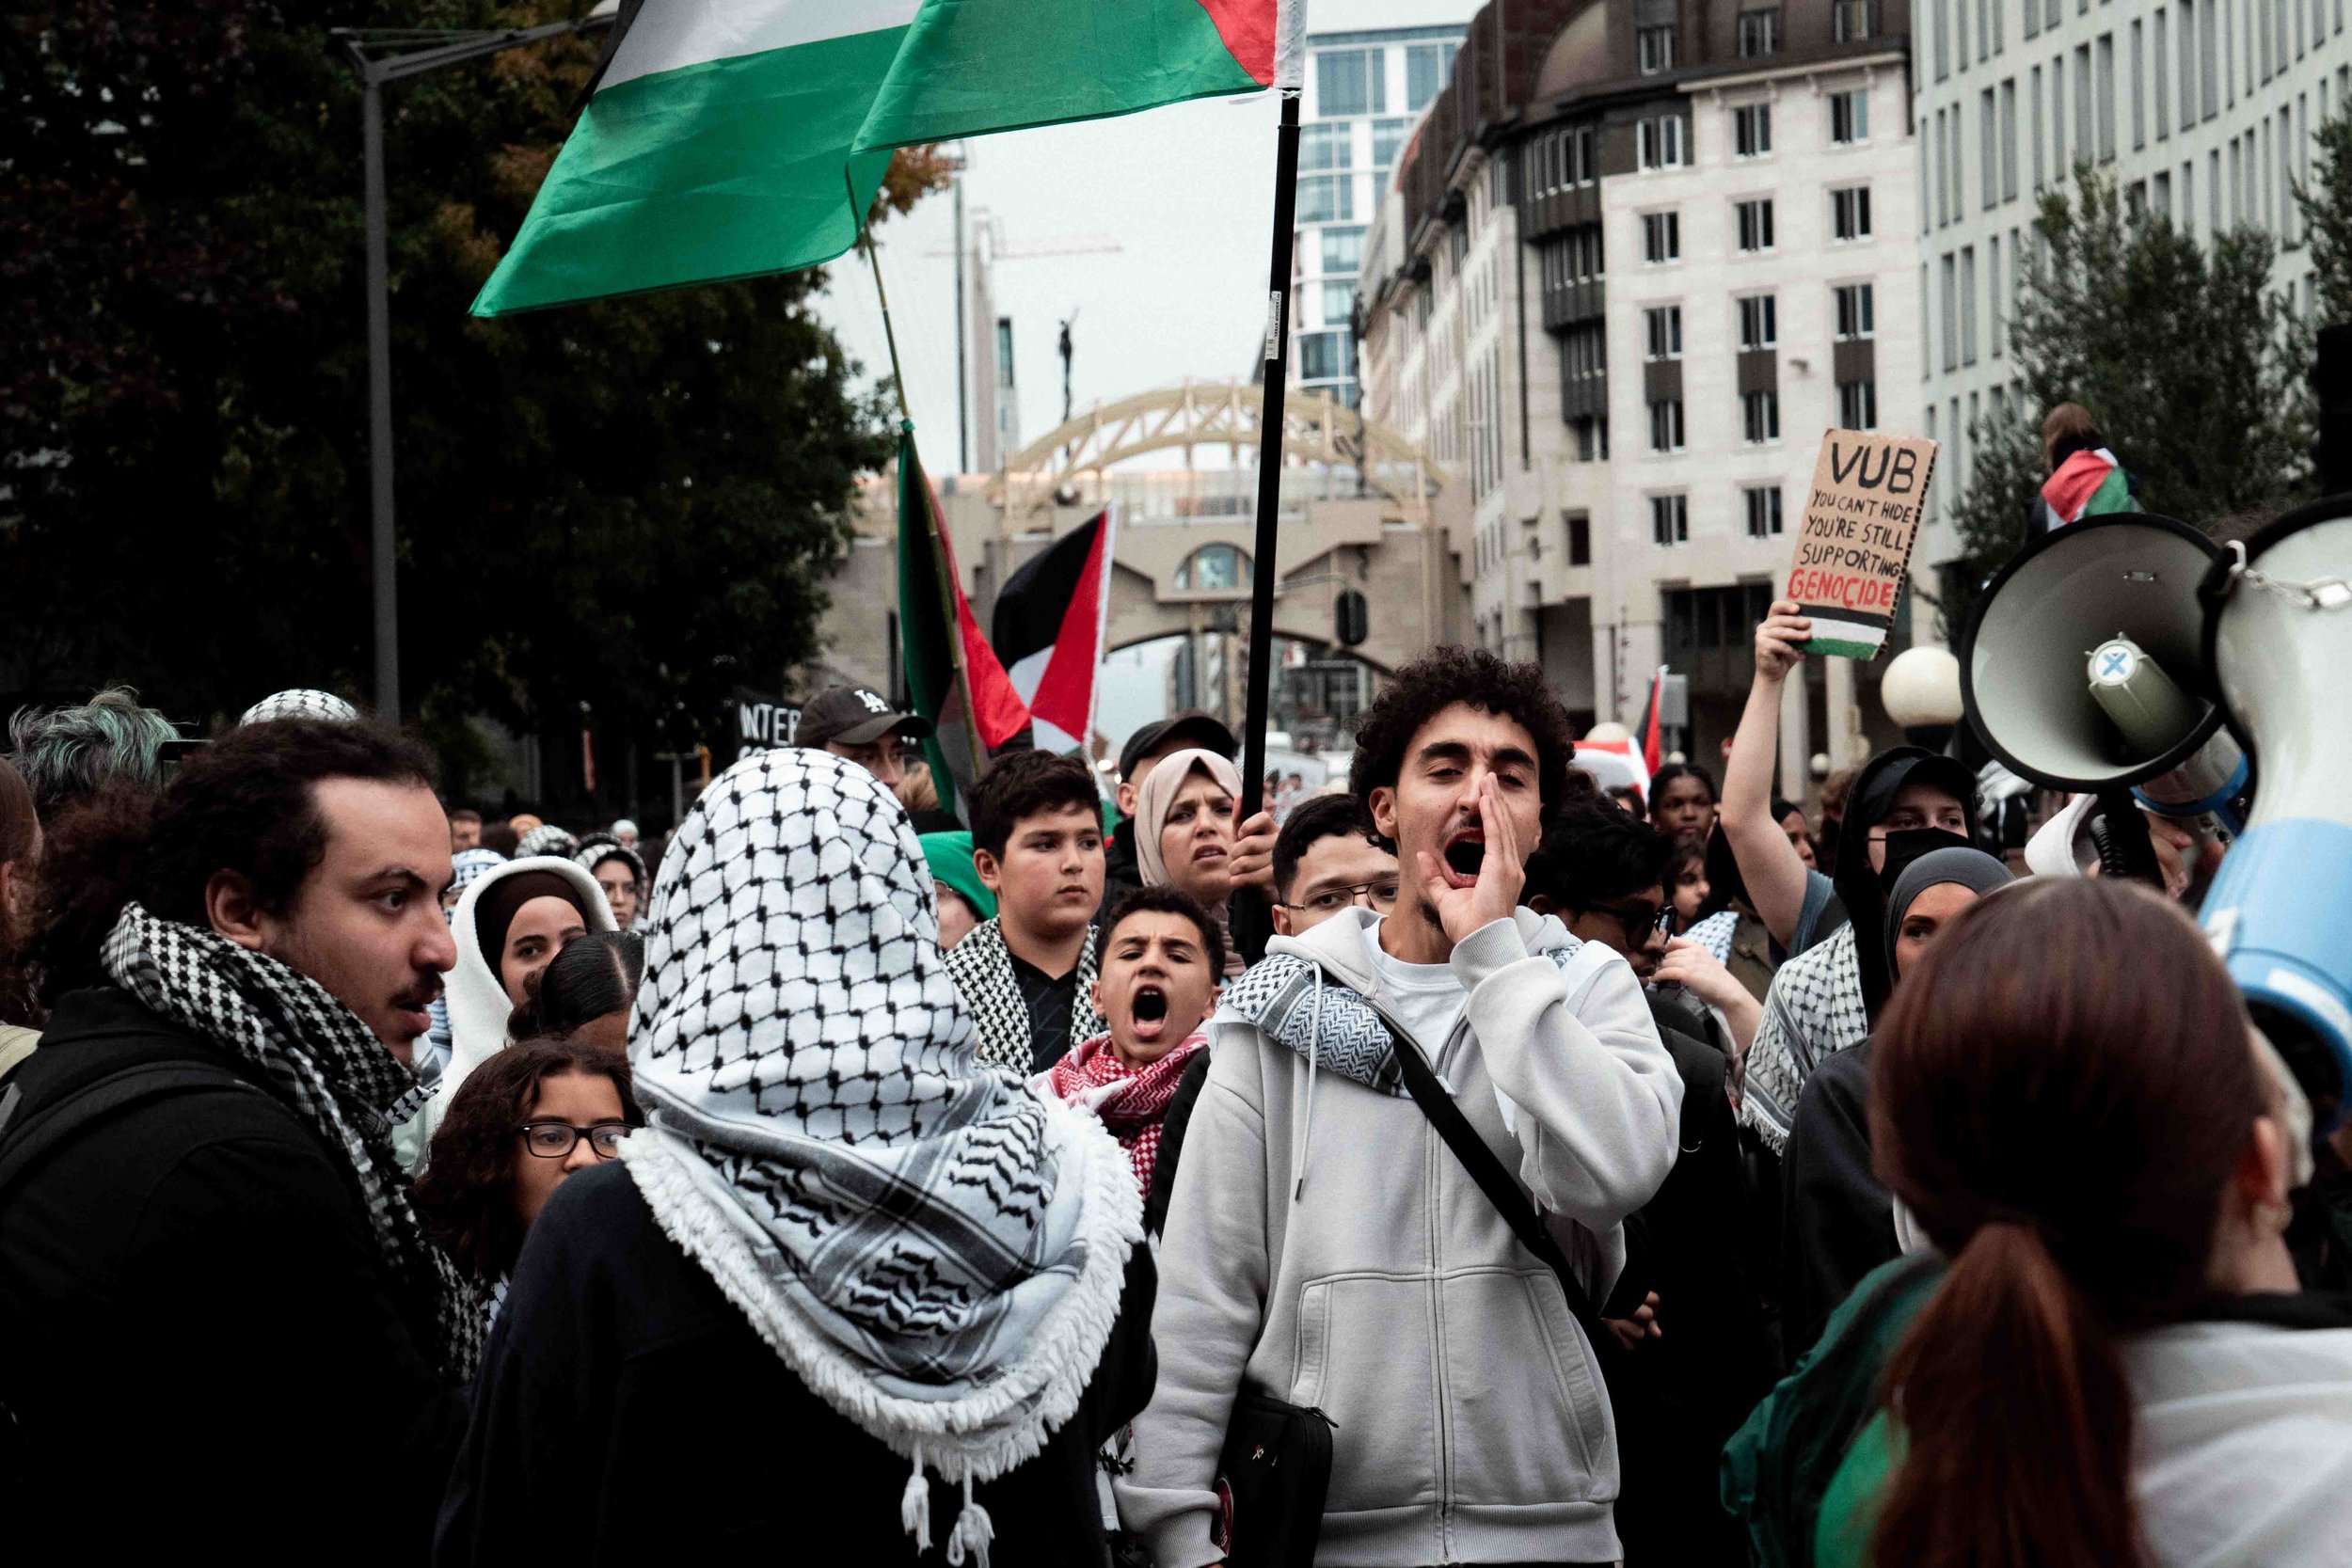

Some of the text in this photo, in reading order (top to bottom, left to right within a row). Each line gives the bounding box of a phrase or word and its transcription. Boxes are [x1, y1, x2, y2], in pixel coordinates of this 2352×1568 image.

[1831, 442, 1917, 494] VUB
[1812, 488, 1914, 524] YOU CAN'T HIDE
[1805, 515, 1904, 551] YOU'RE STILL
[1800, 543, 1901, 578] SUPPORTING
[1788, 568, 1895, 608] GENOCIDE
[853, 689, 889, 713] LA
